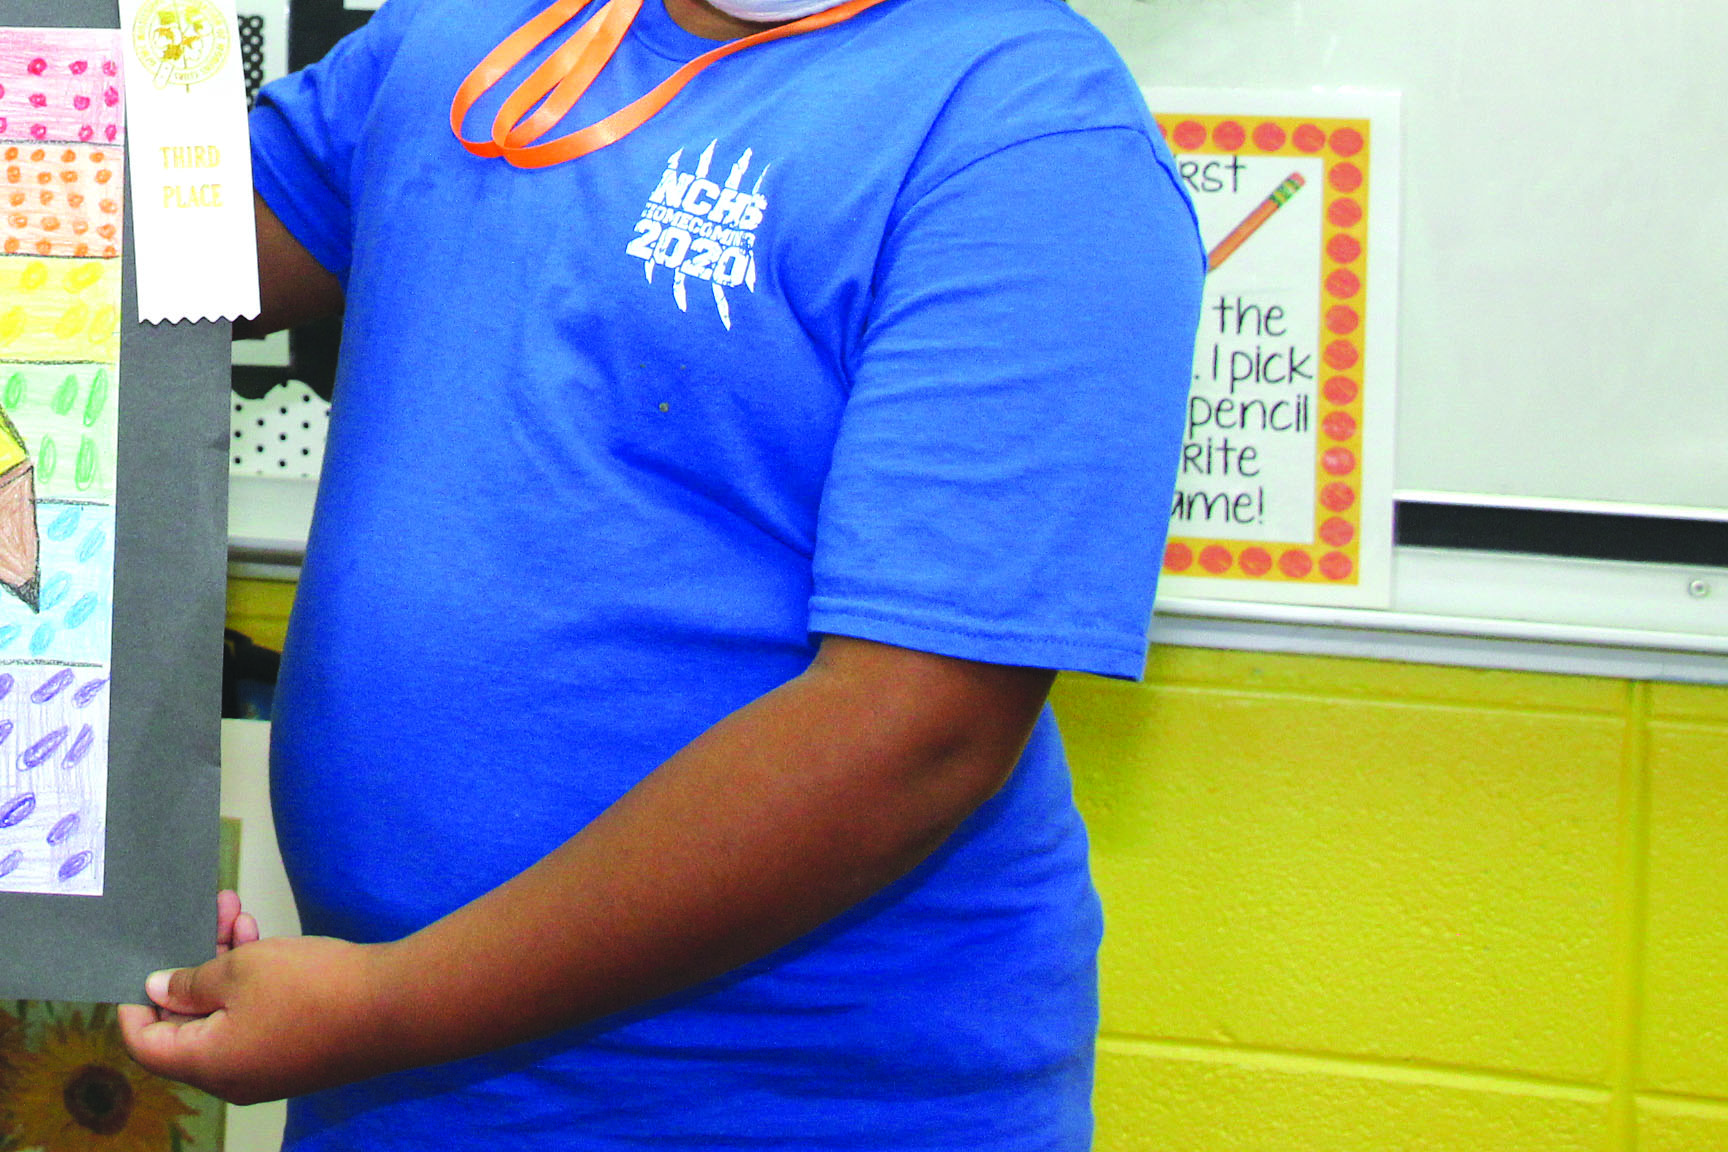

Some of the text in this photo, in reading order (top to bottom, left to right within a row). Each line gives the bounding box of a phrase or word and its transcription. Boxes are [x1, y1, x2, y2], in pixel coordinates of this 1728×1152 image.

[160, 145, 221, 169] THIRD
[162, 183, 223, 209] PLACE
[649, 168, 768, 231] NCHS
[626, 218, 751, 287] 2020
[1212, 296, 1287, 337] the
[1229, 345, 1314, 395] pick
[1188, 393, 1309, 440] pencil
[1171, 485, 1263, 525] ame!
